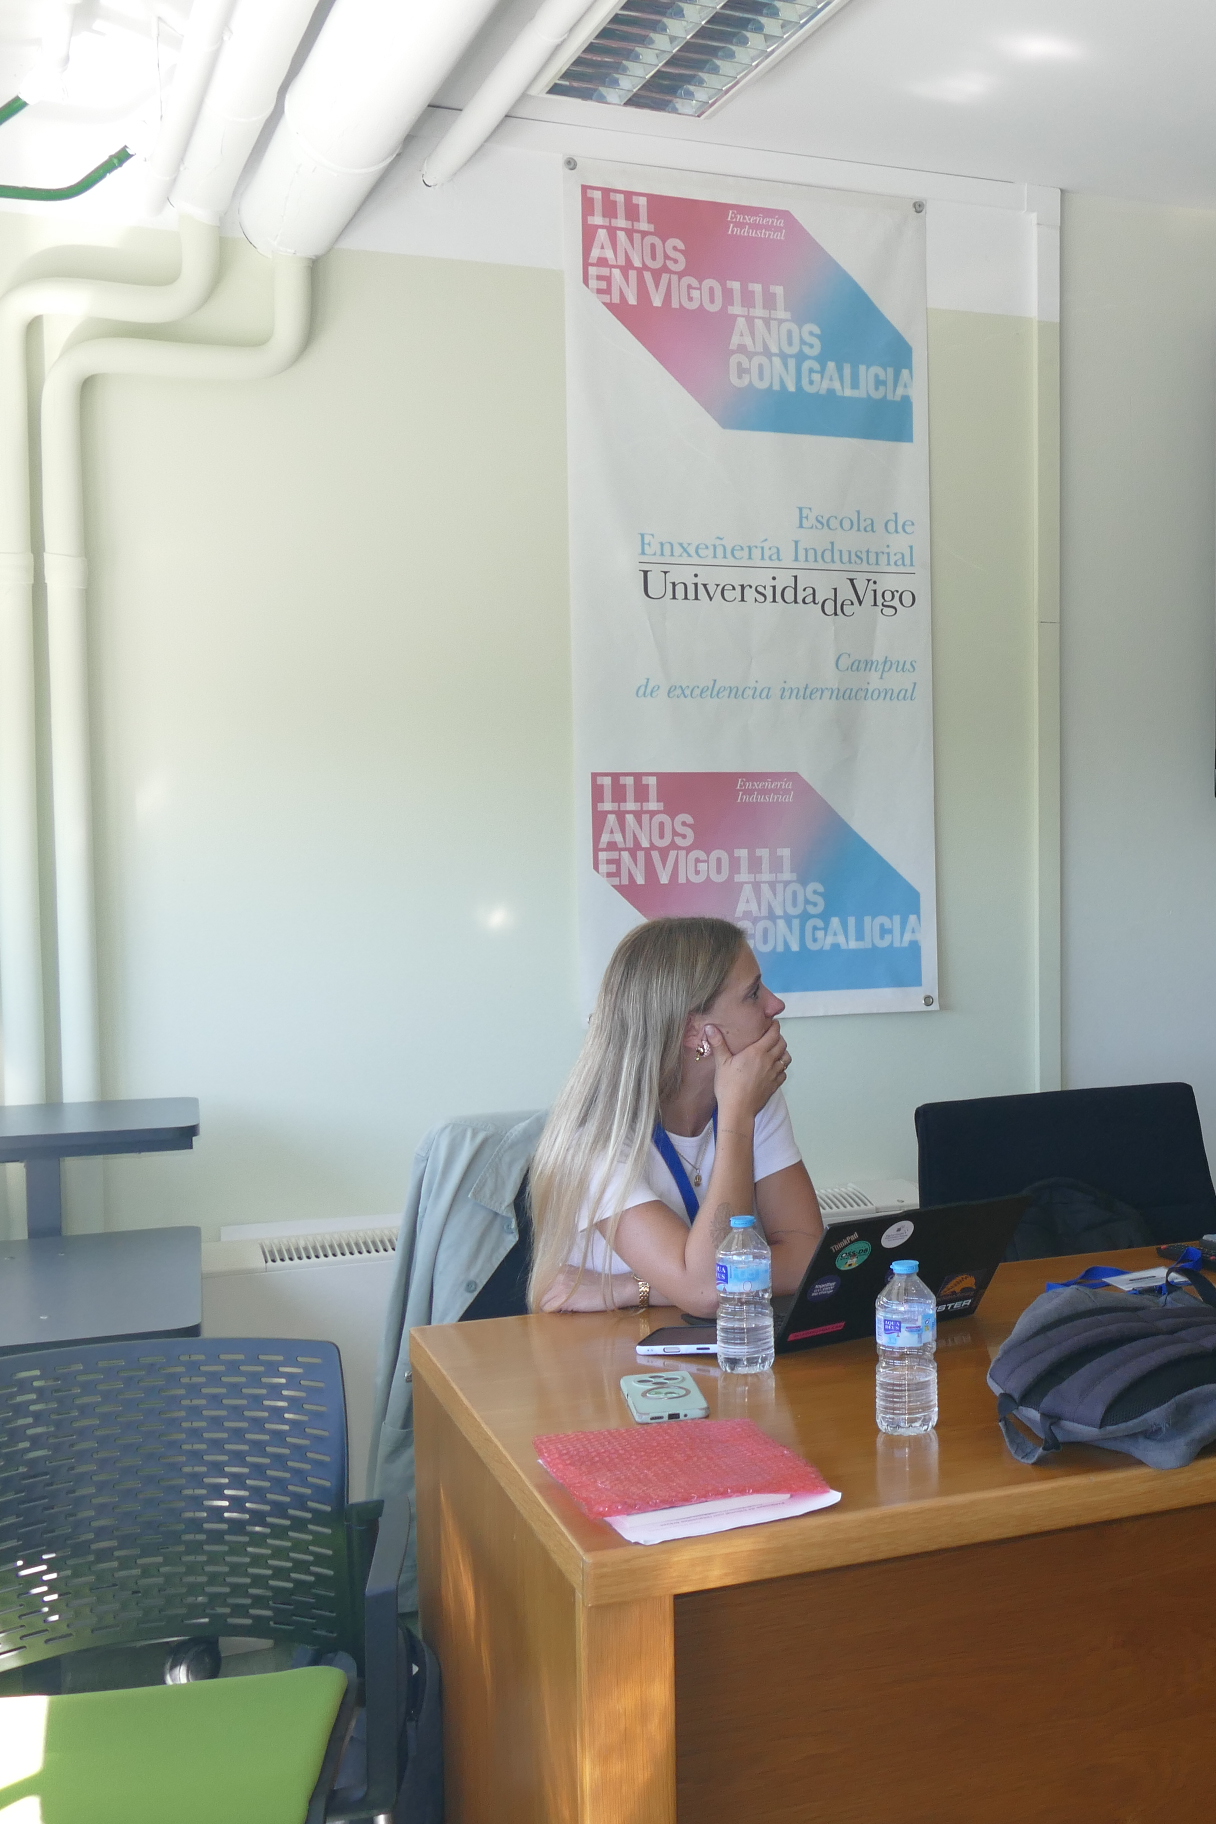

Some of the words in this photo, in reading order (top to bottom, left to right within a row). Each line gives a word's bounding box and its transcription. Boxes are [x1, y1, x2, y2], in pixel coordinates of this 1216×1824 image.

[586, 189, 654, 231] 111
[726, 209, 785, 227] Enxeñería
[588, 228, 686, 272] ANOS
[727, 224, 785, 240] Industrial
[588, 266, 637, 305] EN
[642, 271, 722, 312] VIGO
[727, 280, 791, 319] 111
[729, 317, 822, 356] ANOS
[729, 353, 796, 392] CON
[801, 359, 914, 401] GALICIA
[796, 506, 876, 533] Escola
[884, 512, 915, 535] de
[637, 532, 783, 562] Enxeñería
[791, 539, 915, 567] Industrial
[847, 577, 916, 617] Vigo
[835, 652, 916, 679] Campus
[635, 678, 660, 699] de
[667, 679, 772, 700] excelencia
[780, 680, 917, 701] internacional
[596, 775, 664, 811] 111
[735, 777, 793, 791] Enxeñería
[736, 790, 794, 804] Industrial
[597, 813, 695, 849] ANOS
[598, 851, 645, 886] EN
[652, 849, 730, 884] VIGO
[733, 848, 797, 882] 111
[734, 882, 825, 918] ANOS
[805, 914, 922, 951] GALICIA
[830, 1231, 859, 1253] ThinkPad
[936, 1299, 972, 1313] STER
